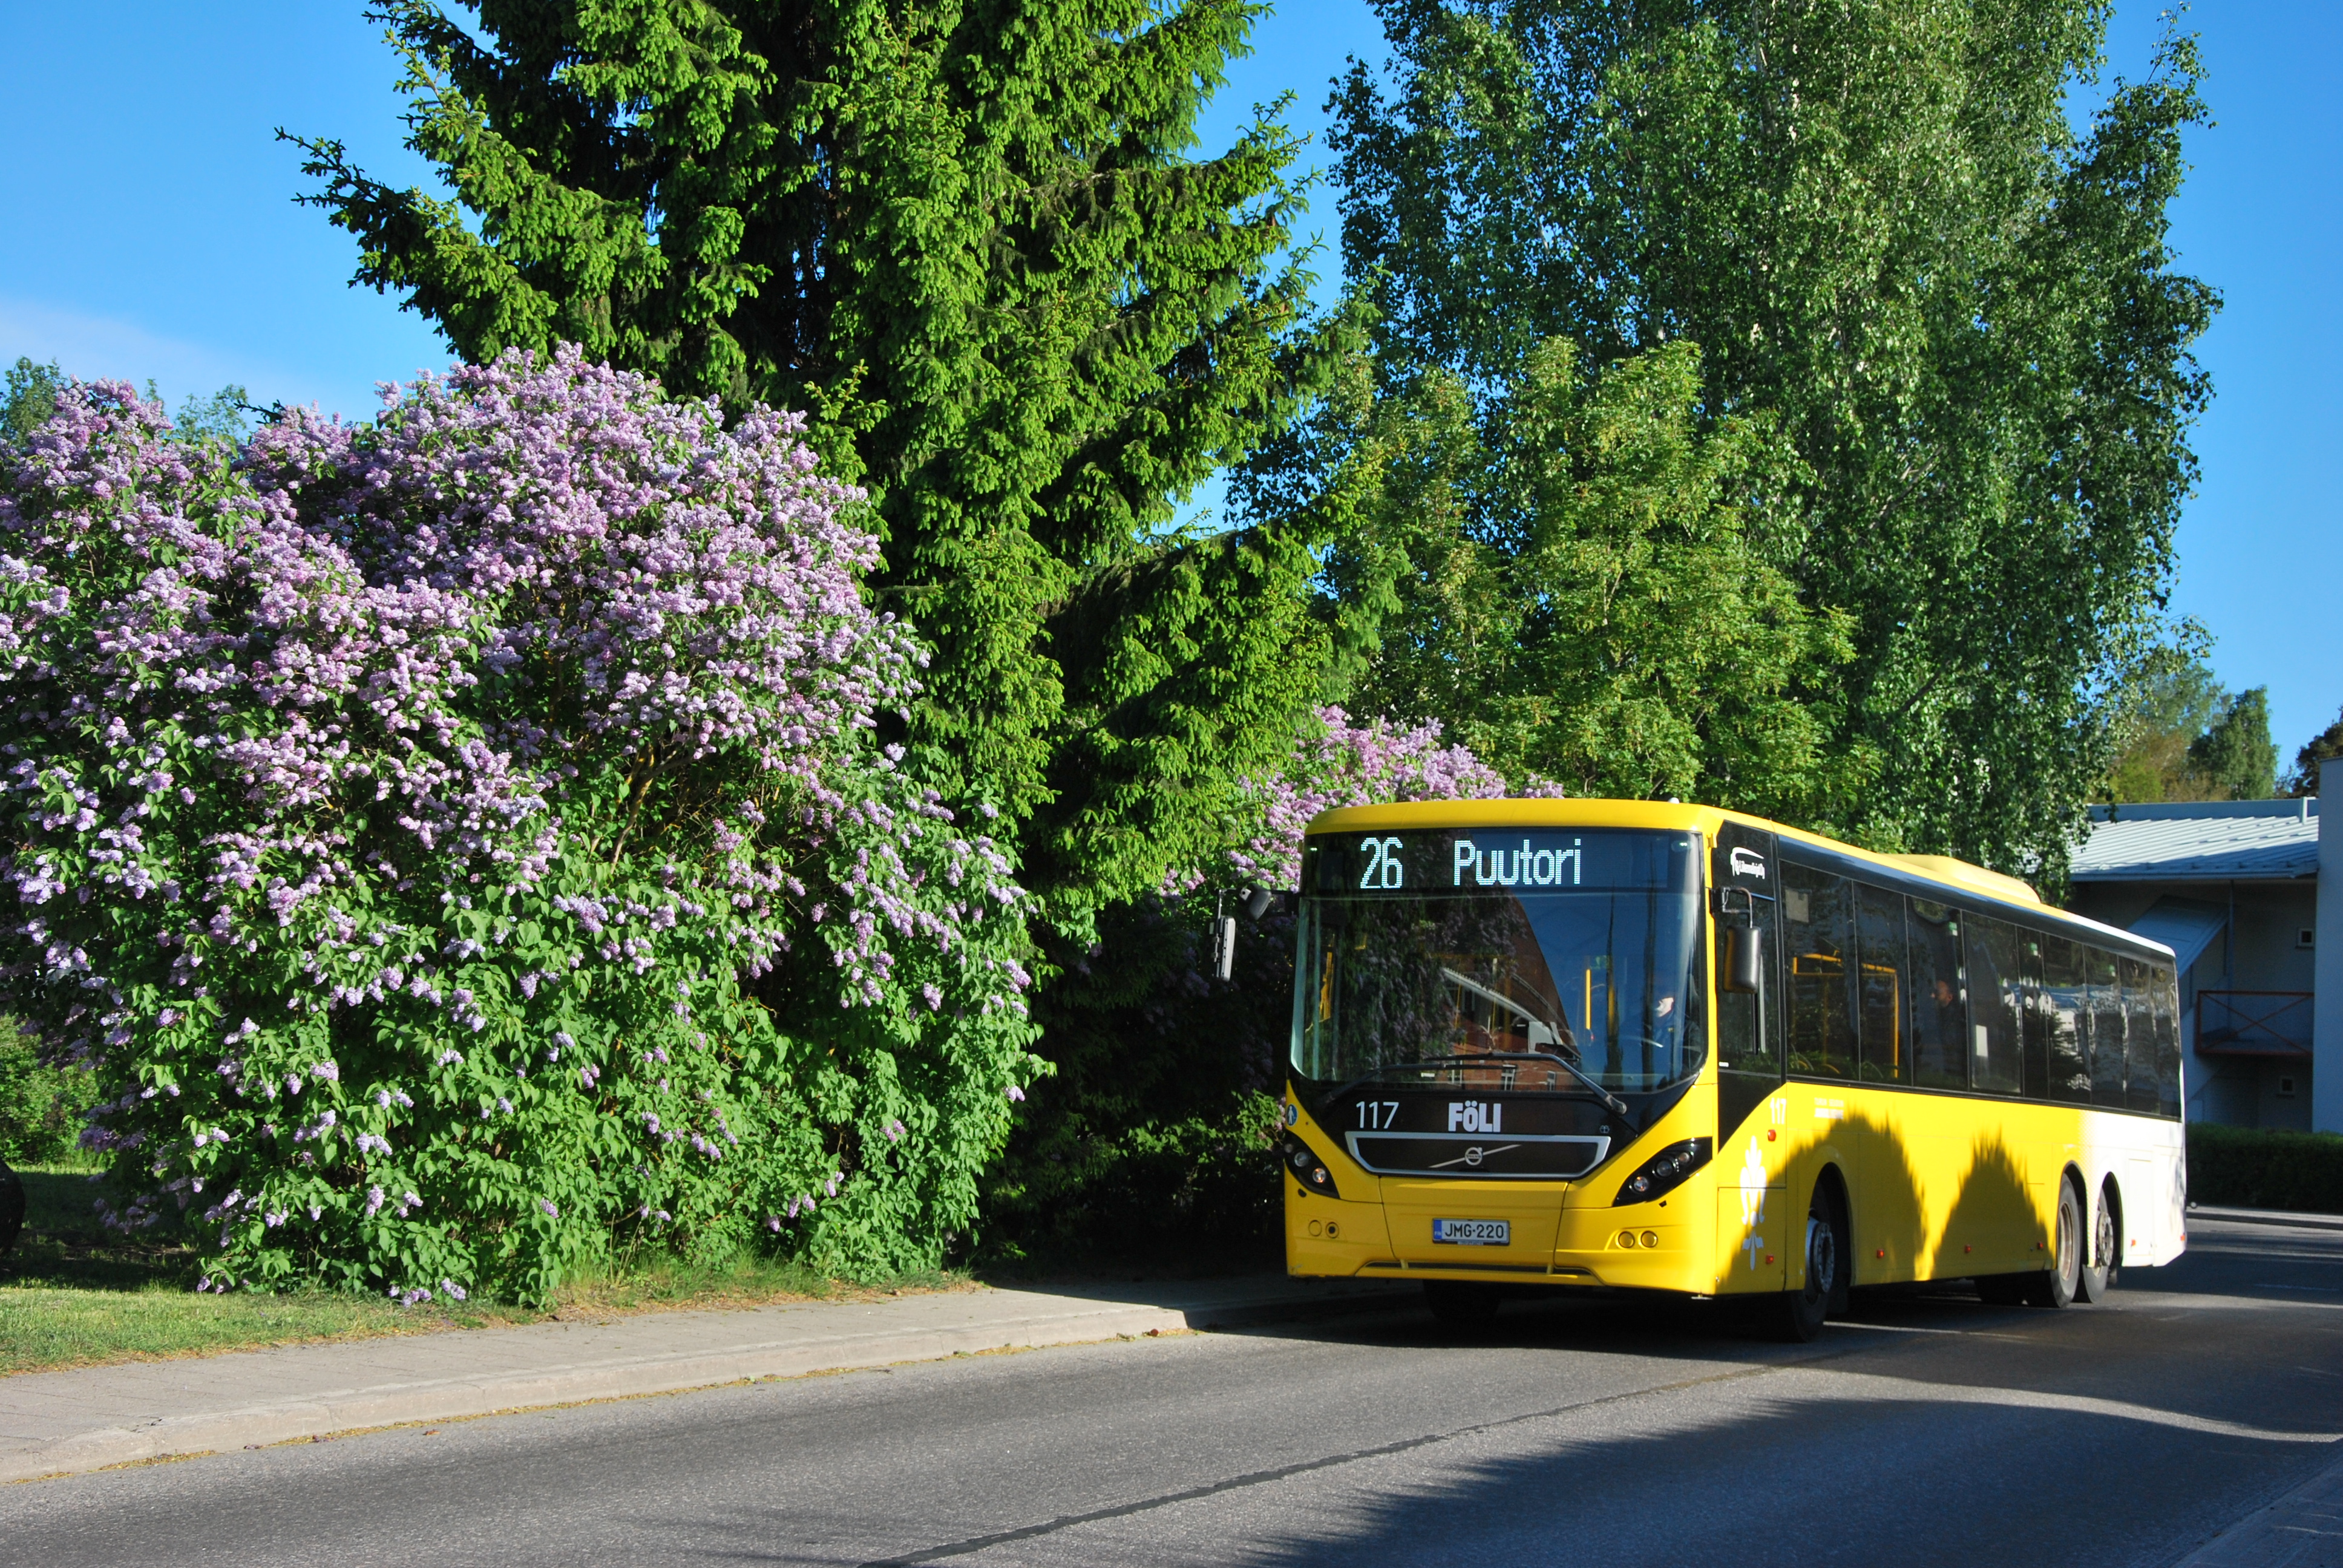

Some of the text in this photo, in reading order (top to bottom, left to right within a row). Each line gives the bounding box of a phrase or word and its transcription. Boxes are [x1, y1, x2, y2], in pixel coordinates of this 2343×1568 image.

[1360, 837, 1581, 889] 26 Puutori
[1356, 1101, 1399, 1129] 117
[1448, 1100, 1501, 1132] FÖLI
[1770, 1097, 1786, 1125] 117
[1445, 1223, 1504, 1239] JMG-220
